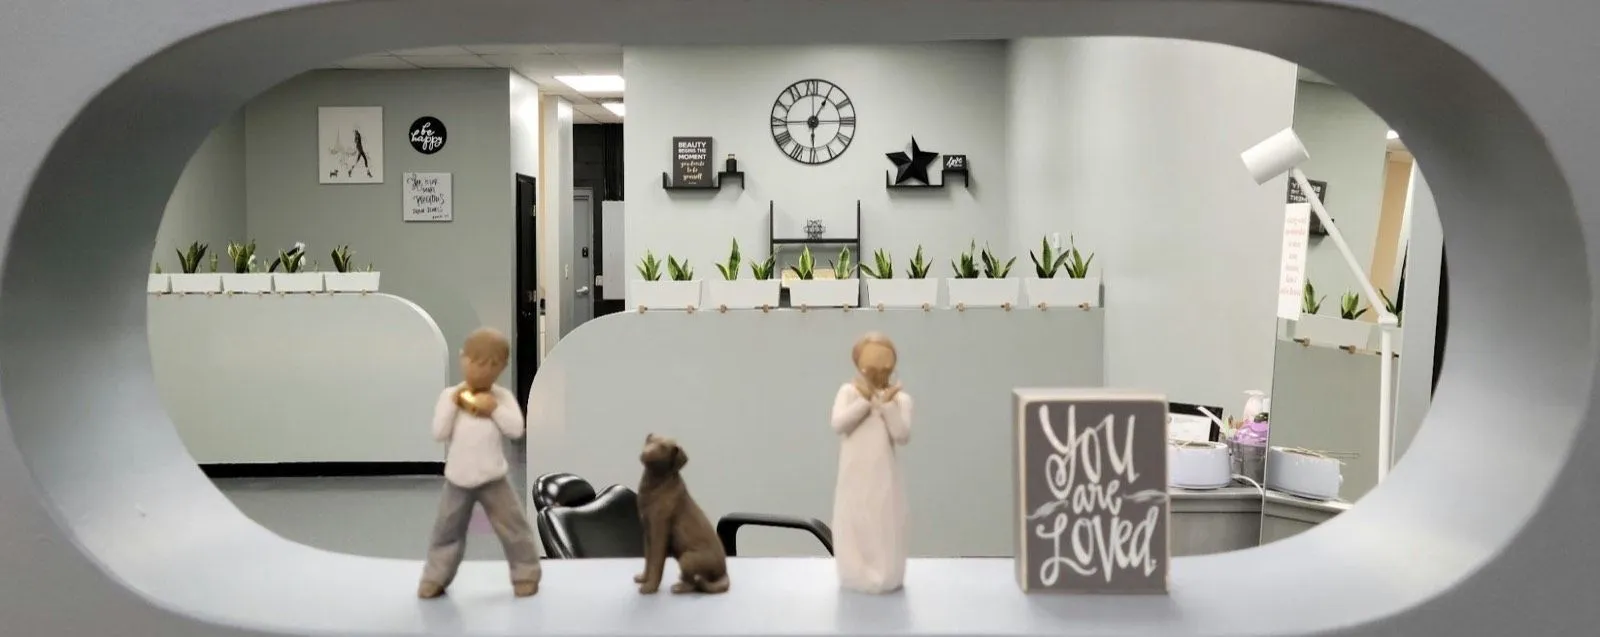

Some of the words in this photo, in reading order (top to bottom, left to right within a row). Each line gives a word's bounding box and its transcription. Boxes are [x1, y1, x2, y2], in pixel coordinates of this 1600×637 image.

[410, 129, 443, 151] happy
[421, 122, 435, 136] be
[1072, 478, 1123, 516] are
